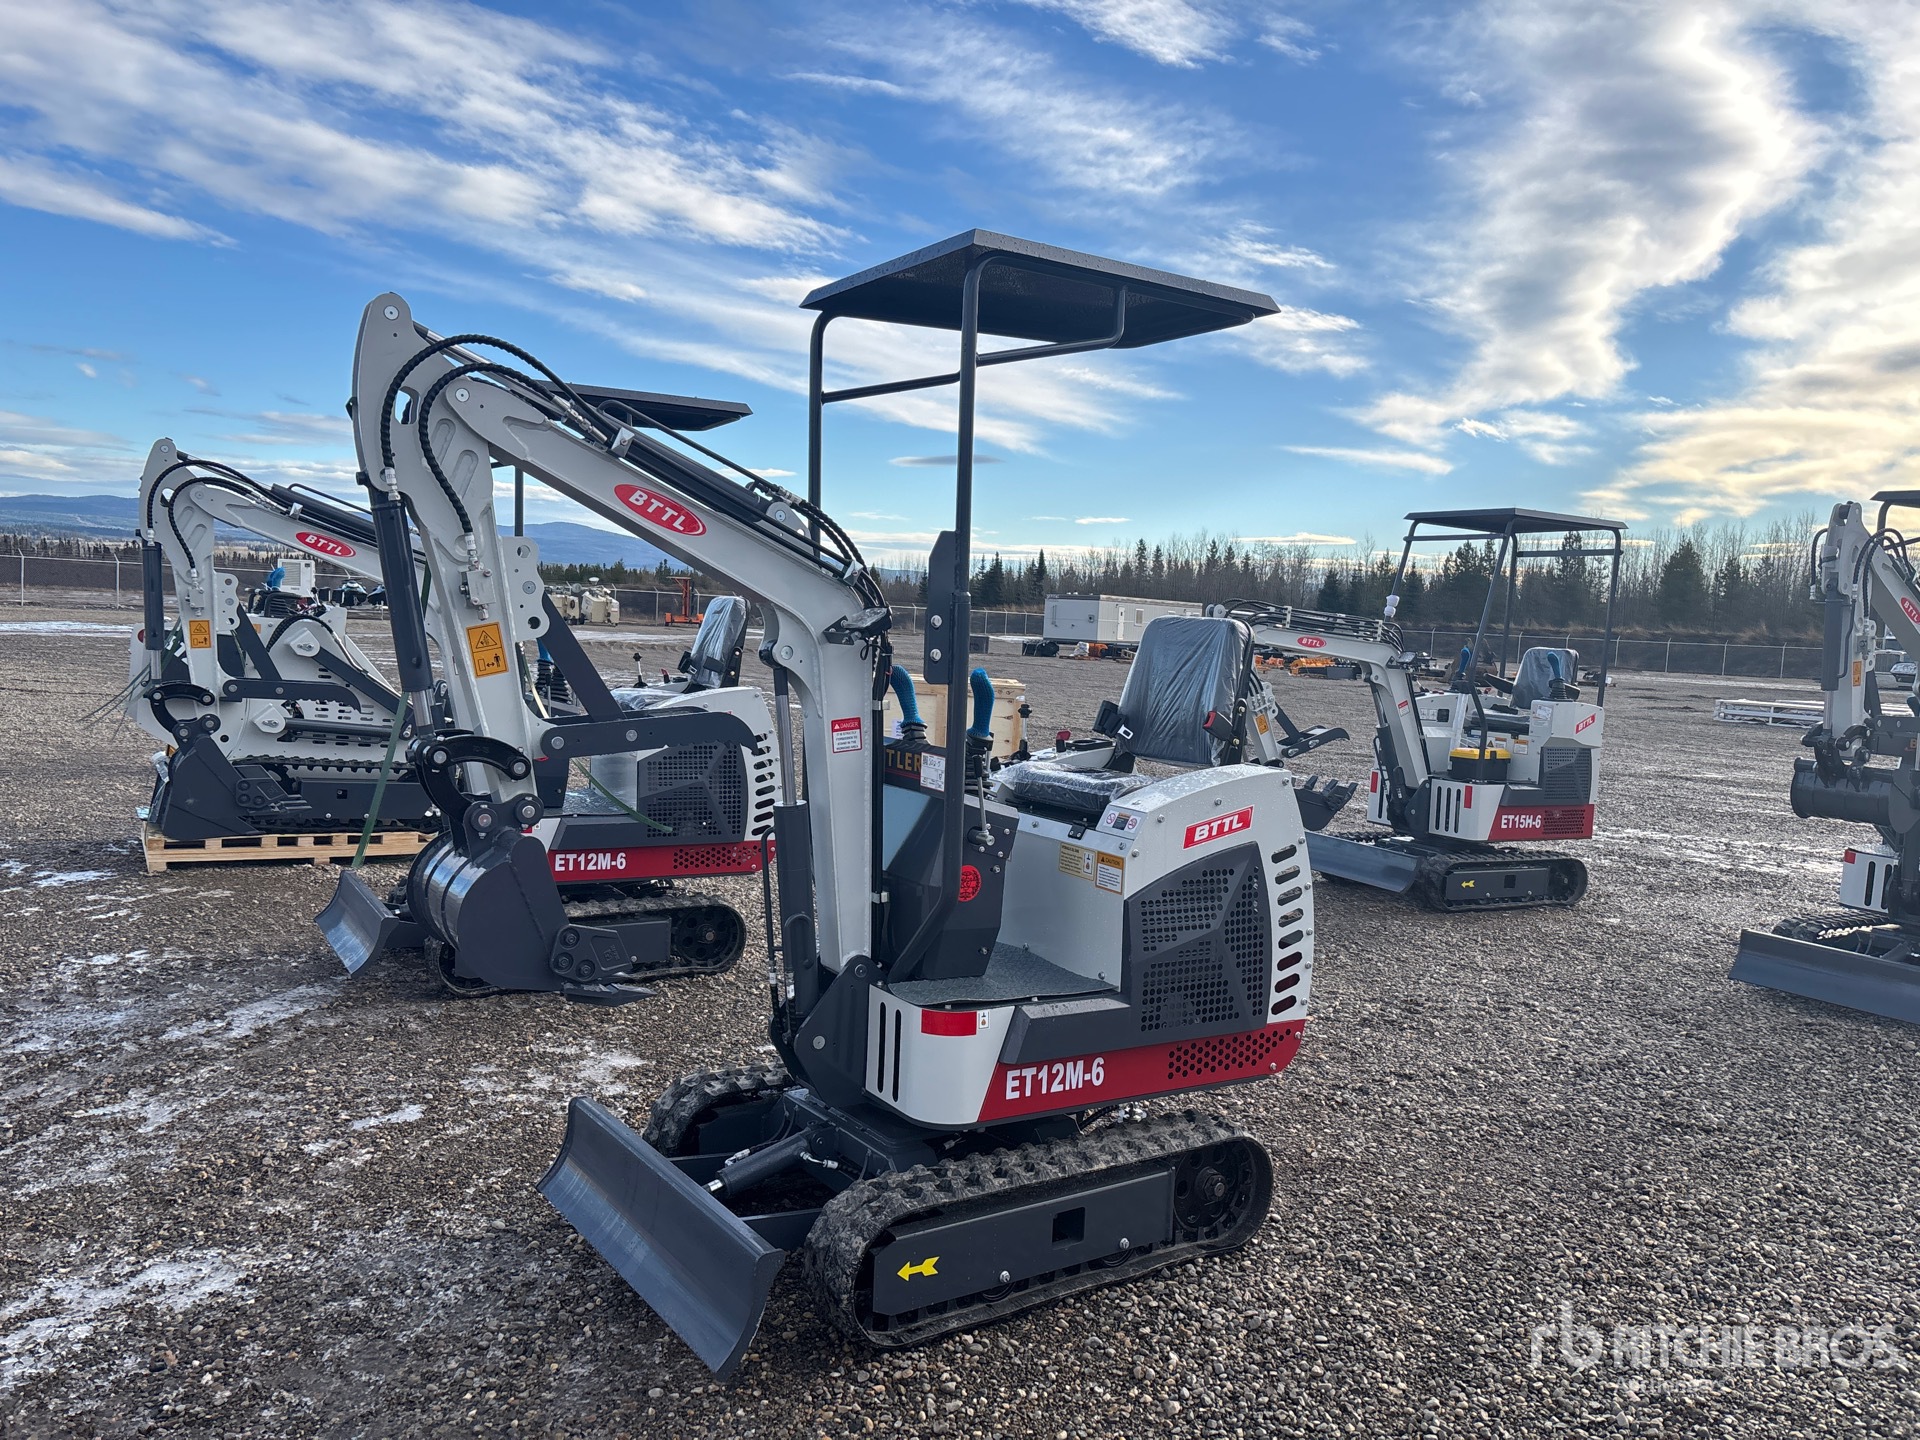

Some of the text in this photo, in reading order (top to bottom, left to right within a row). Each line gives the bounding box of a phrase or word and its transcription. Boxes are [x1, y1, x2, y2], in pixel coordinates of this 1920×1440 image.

[628, 489, 686, 532] BTTL
[305, 534, 342, 555] BTTL
[1903, 600, 1918, 622] BTTL
[1301, 637, 1321, 647] BTTL
[840, 721, 859, 729] DANGER
[1577, 716, 1594, 732] BTTL
[1193, 814, 1244, 842] BTTL
[1501, 814, 1542, 829] ET15H-6
[554, 852, 627, 872] ET12M-6
[1105, 857, 1121, 867] CAUTION
[1005, 1056, 1105, 1101] ET12M-6
